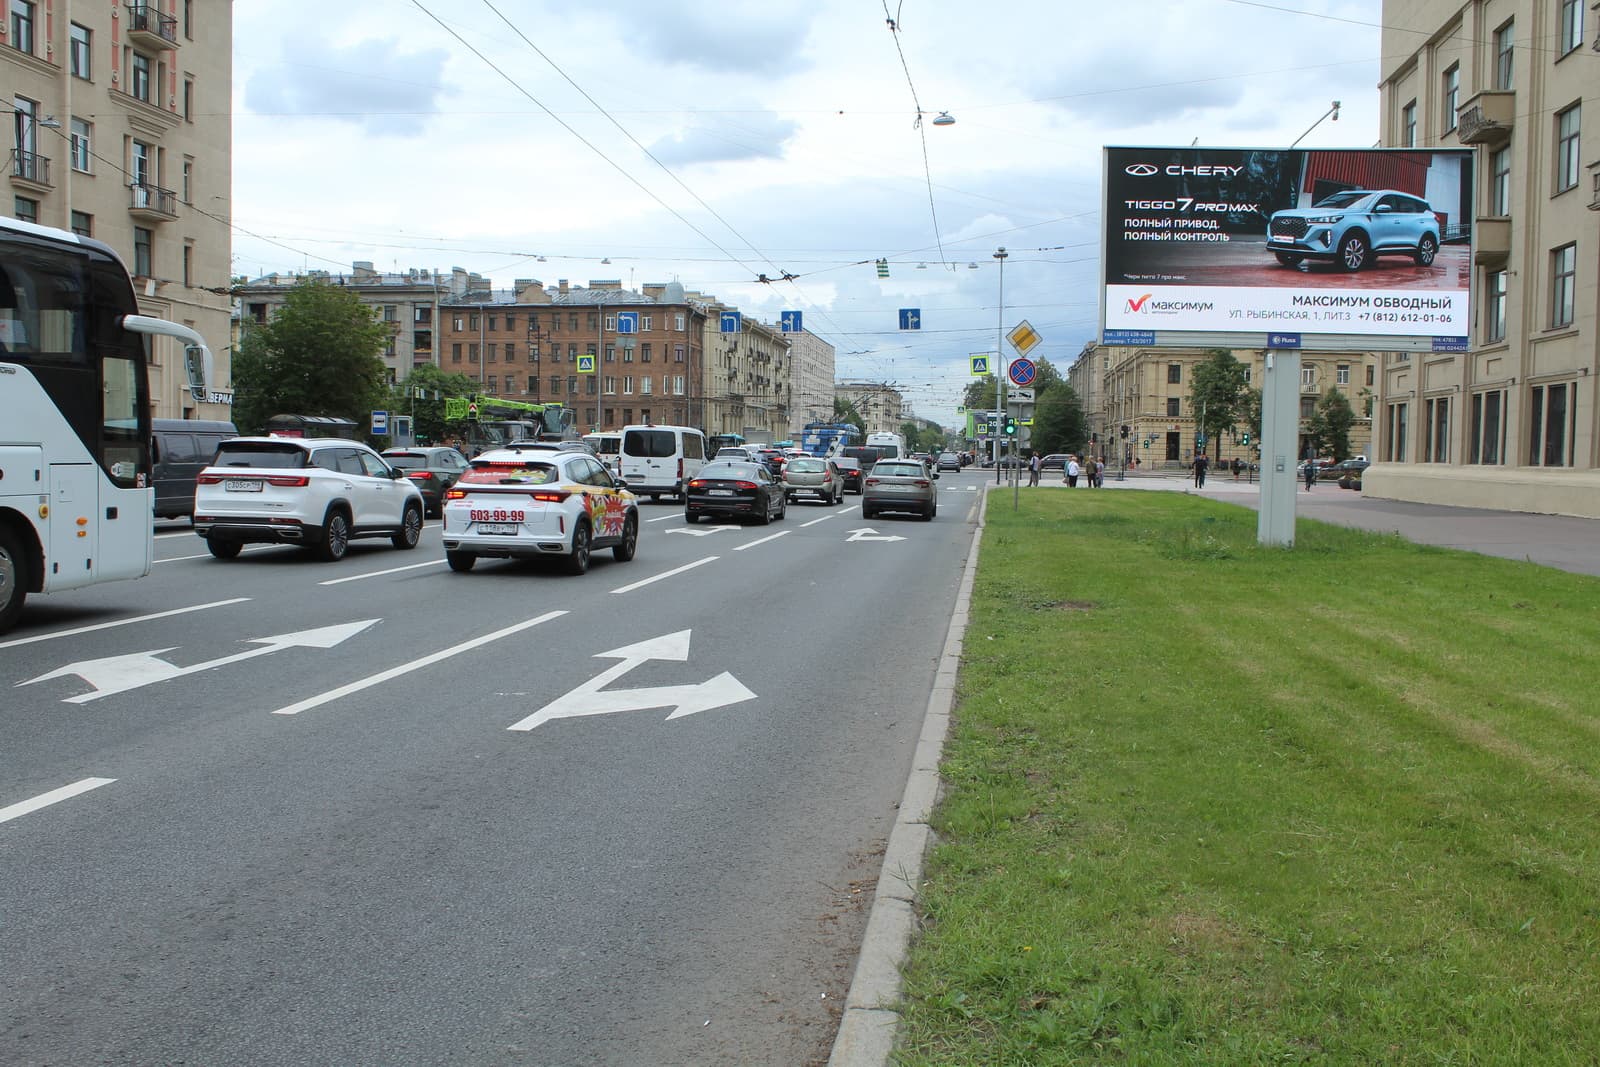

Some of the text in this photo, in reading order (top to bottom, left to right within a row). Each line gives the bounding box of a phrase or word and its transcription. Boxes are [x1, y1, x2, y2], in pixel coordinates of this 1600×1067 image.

[1165, 165, 1243, 176] CHERY
[1125, 198, 1258, 213] TIGGO 7 PRO MAX
[1124, 217, 1172, 229] ПОЛНЫЙ
[1124, 230, 1230, 242] ПОЛНЫЙ КОНТРОЛЬ
[1151, 301, 1214, 312] максимум
[1292, 295, 1452, 310] МАКСИМУМ ОБВОДНЫЙ
[1229, 310, 1243, 319] УЛ.
[1359, 313, 1452, 323] +7 (812) 612-01-06
[470, 509, 525, 521] 603-99-99
